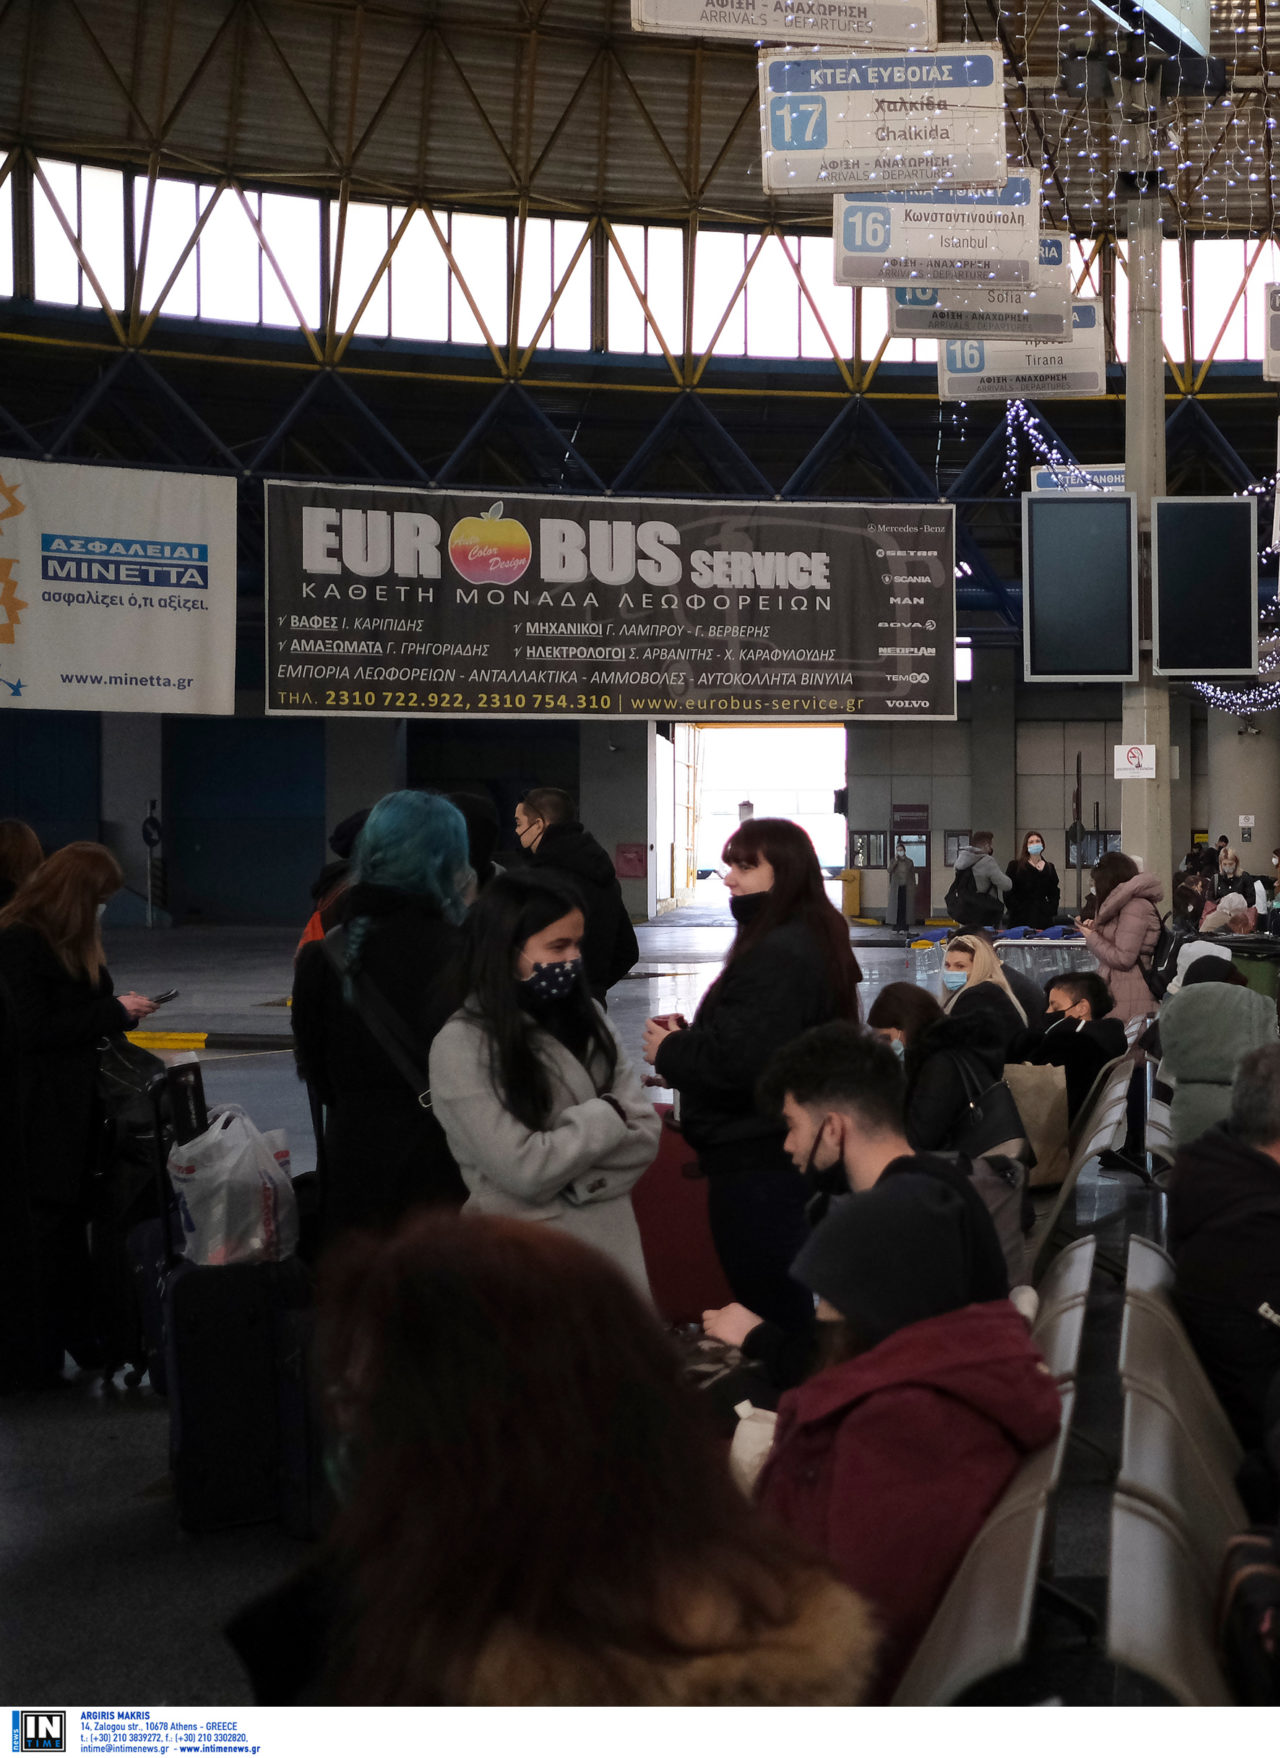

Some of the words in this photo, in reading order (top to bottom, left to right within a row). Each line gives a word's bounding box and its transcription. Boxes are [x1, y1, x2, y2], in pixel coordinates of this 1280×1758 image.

[773, 0, 868, 19] ΑΝΑΧΩΡΗΣΗ
[700, 10, 768, 26] ARRIVALS
[784, 17, 874, 33] DEPARTURES
[810, 69, 860, 85] ΚΤΕΛ
[867, 65, 953, 84] ΕΥΒΟΙΑΣ
[775, 103, 824, 143] 17
[875, 124, 950, 142] Chalkida
[820, 158, 860, 170] ΑΦΙΞΗ
[875, 156, 950, 169] ΑΝΑΧΩΡΗΣΗ
[816, 170, 869, 182] ARRIVALS
[883, 168, 955, 181] DEPARTURES
[904, 208, 1025, 227] Κωνσταντινούπολη
[848, 212, 885, 247] 16
[940, 235, 988, 249] Istanbul
[987, 290, 1021, 304] Sofia
[932, 311, 963, 320] ΑΦΙΞΗ
[971, 312, 1030, 322] ΑΝΑΧΩΡΗΣΗ
[949, 340, 981, 369] 16
[1025, 354, 1064, 366] Tirana
[1087, 474, 1125, 484] ΑΝΘΗΣ
[877, 524, 946, 533] Mercedes-Benz
[49, 538, 200, 560] ΑΣΦΑΛΕΙΑΙ
[468, 545, 498, 561] Color
[47, 559, 204, 586] MINETTA
[489, 557, 527, 571] Design
[690, 549, 831, 590] SERVICE
[893, 575, 932, 583] SCANIA
[41, 591, 124, 608] ασφαλίζει
[128, 593, 154, 609] ό,τι
[158, 595, 209, 612] αξίζει.
[302, 582, 433, 603] ΚΑΘΕΤΗ
[456, 588, 599, 607] ΜΟΝΑΔΑ
[618, 593, 831, 611] ΛΕΩΦΟΡΕΙΩΝ
[889, 596, 925, 605] MAN
[290, 615, 338, 630] ΒΑΦΕΣ
[353, 617, 424, 632] ΚΑΡΙΠΙΔΗΣ
[526, 622, 603, 636] ΜΗΧΑΝΙΚΟΙ
[606, 624, 616, 636] Γ.
[619, 624, 685, 637] ΛΑΜΠΡΟΥ
[695, 625, 705, 637] Γ.
[708, 625, 771, 638] ΒΕΡΒΕΡΗΣ
[290, 638, 383, 654] ΑΜΑΞΩΜΑΤΑ
[386, 641, 397, 655] Γ.
[400, 642, 490, 657] ΓΡΗΓΟΡΙΑΔΗΣ
[526, 645, 626, 660] ΗΛΕΚΤΡΟΛΟΓΟΙ
[629, 648, 639, 660] Σ.
[642, 648, 714, 661] ΑΡΒΑΝΙΤΗΣ
[724, 649, 735, 661] Χ.
[738, 649, 837, 662] ΚΑΡΑΦΥΛΟΥΔΗΣ
[878, 646, 937, 656] NEOPLAN
[60, 672, 194, 689] www.minetta.gr
[277, 664, 350, 680] ΕΜΠΟΡΙΑ
[353, 666, 456, 682] ΛΕΩΦΟΡΕΙΩΝ
[468, 669, 578, 683] ΑΝΤΑΛΛΑΚΤΙΚΑ
[590, 671, 687, 685] ΑΜΜΟΒΟΛΕΣ
[697, 672, 797, 686] ΑΥΤΟΚΟΛΛΗΤΑ
[800, 672, 854, 686] ΒΙΝΥΛΙΑ
[277, 691, 318, 705] ΤΗΛ.
[325, 690, 376, 706] 2310
[382, 691, 471, 710] 722.922,
[477, 693, 526, 708] 2310
[532, 694, 611, 709] 754.310
[630, 696, 865, 713] www.eurobus-service.gr
[885, 700, 930, 708] VOLVO
